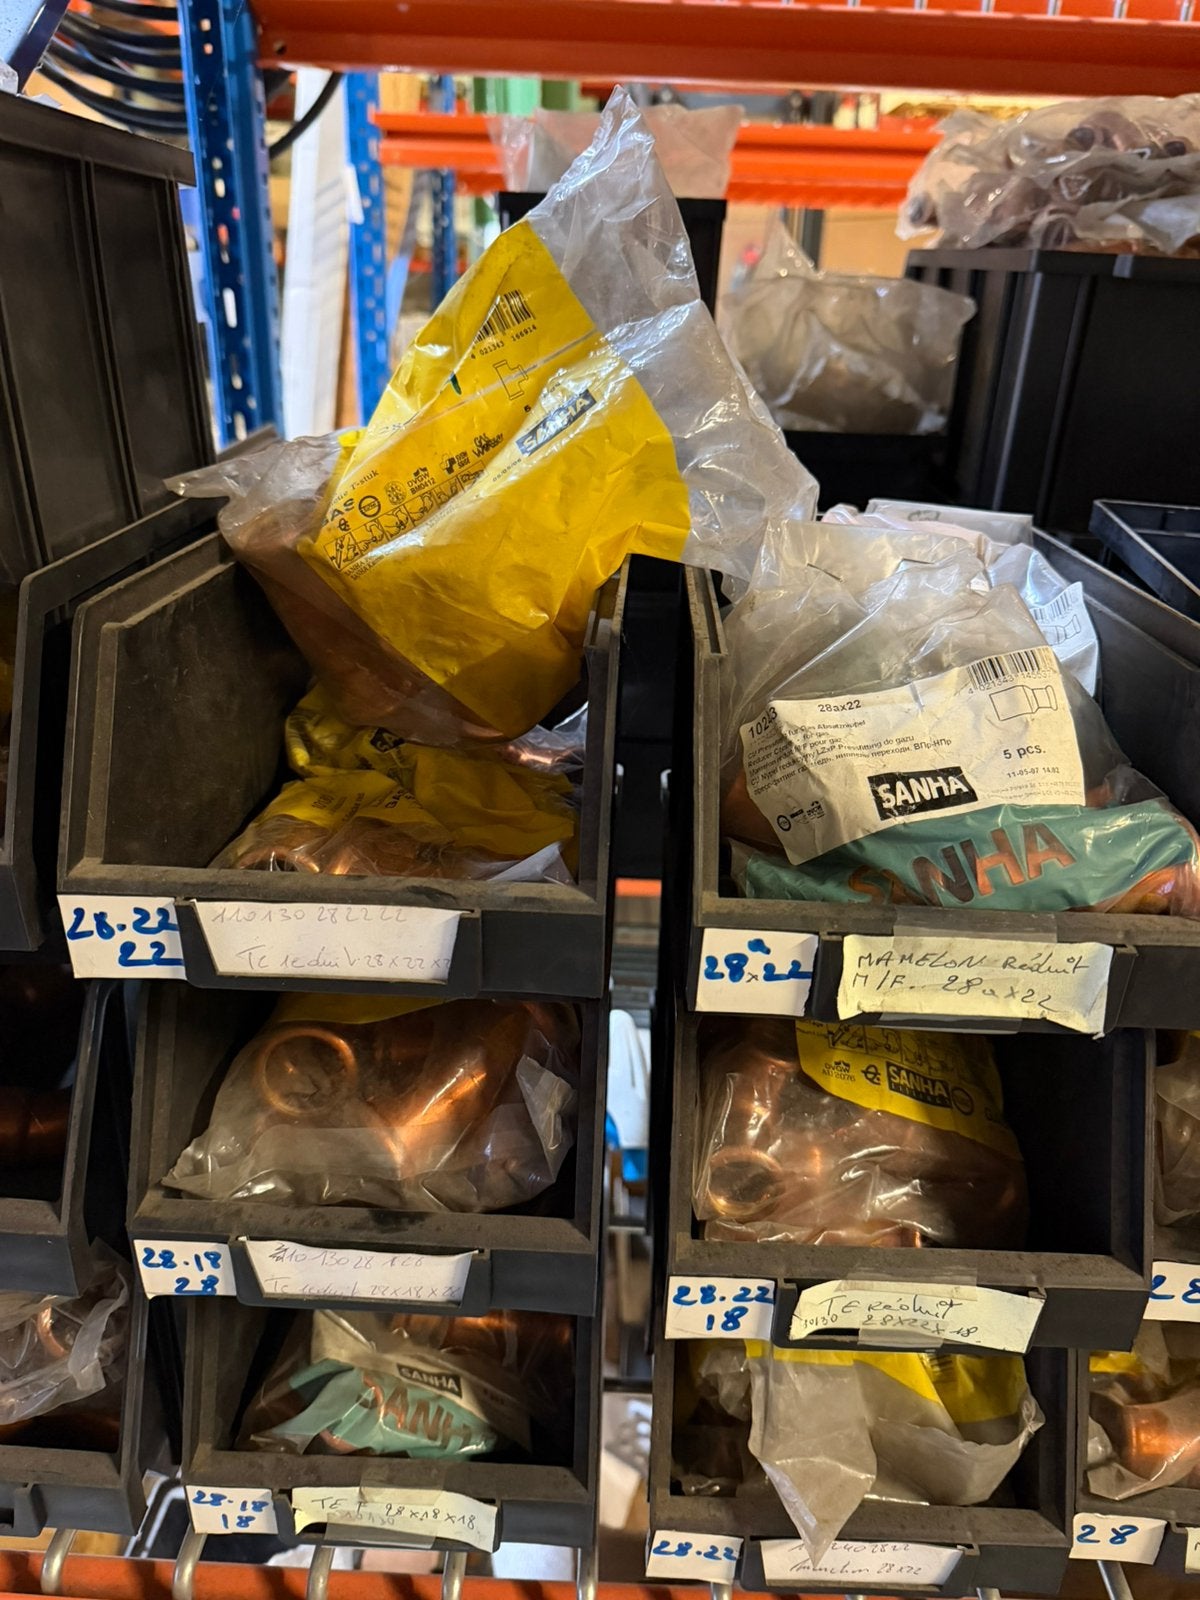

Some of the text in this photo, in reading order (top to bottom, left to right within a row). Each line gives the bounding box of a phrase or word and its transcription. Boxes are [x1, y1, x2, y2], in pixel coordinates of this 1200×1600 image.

[818, 699, 862, 713] 28ax22
[1003, 744, 1046, 759] 5 pcs.
[877, 775, 969, 810] SANHA
[67, 907, 180, 940] 28.22
[118, 941, 185, 967] 22
[889, 1065, 947, 1099] SANHA
[174, 1274, 220, 1295] 28
[672, 1284, 776, 1307] 28.22
[706, 1305, 749, 1332] 18
[400, 1366, 460, 1393] SANHA
[221, 1513, 256, 1530] 18
[1076, 1524, 1139, 1545] 28
[652, 1540, 738, 1561] 28.22
